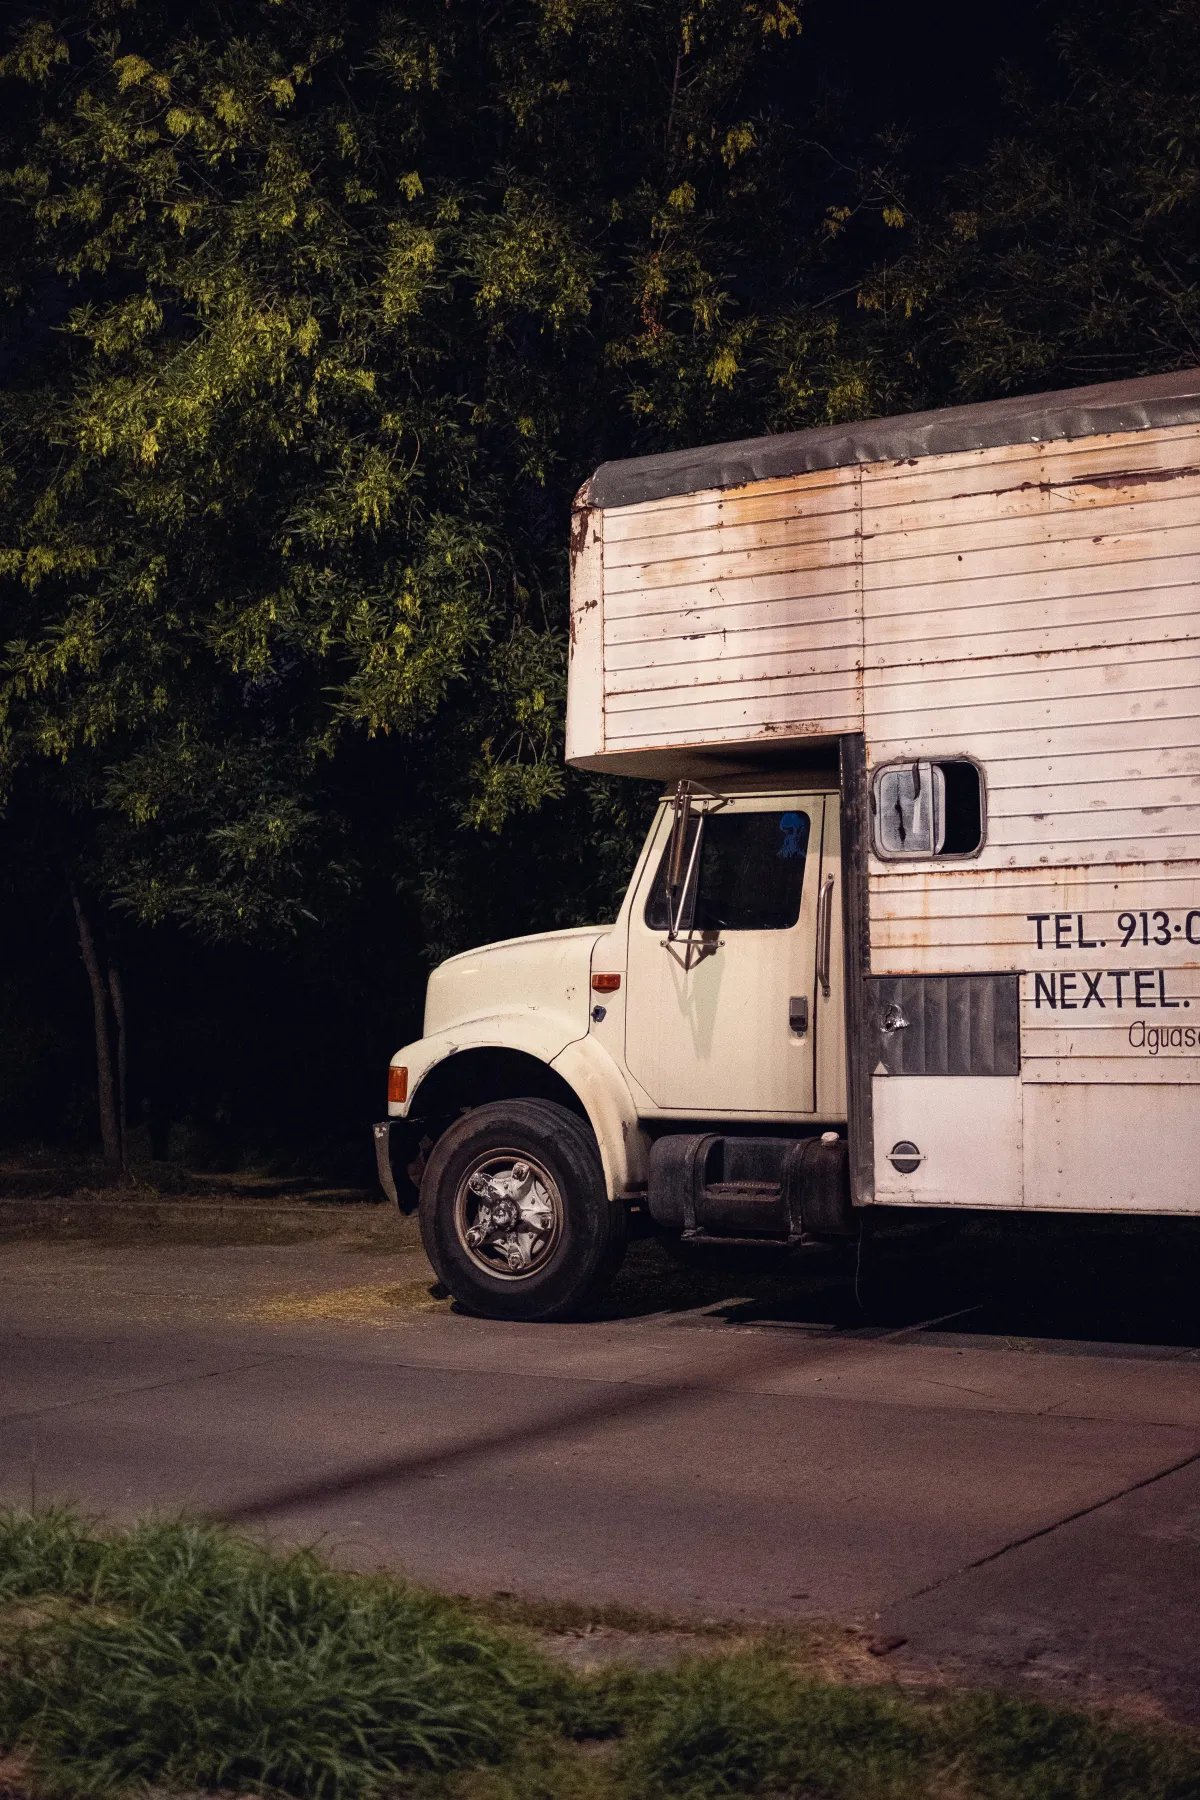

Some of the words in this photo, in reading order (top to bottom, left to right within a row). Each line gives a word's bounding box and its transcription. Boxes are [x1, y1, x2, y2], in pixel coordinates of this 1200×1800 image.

[1027, 914, 1106, 949] TEL.
[1035, 970, 1190, 1009] NEXTEL.
[1128, 1020, 1200, 1055] Aguas
